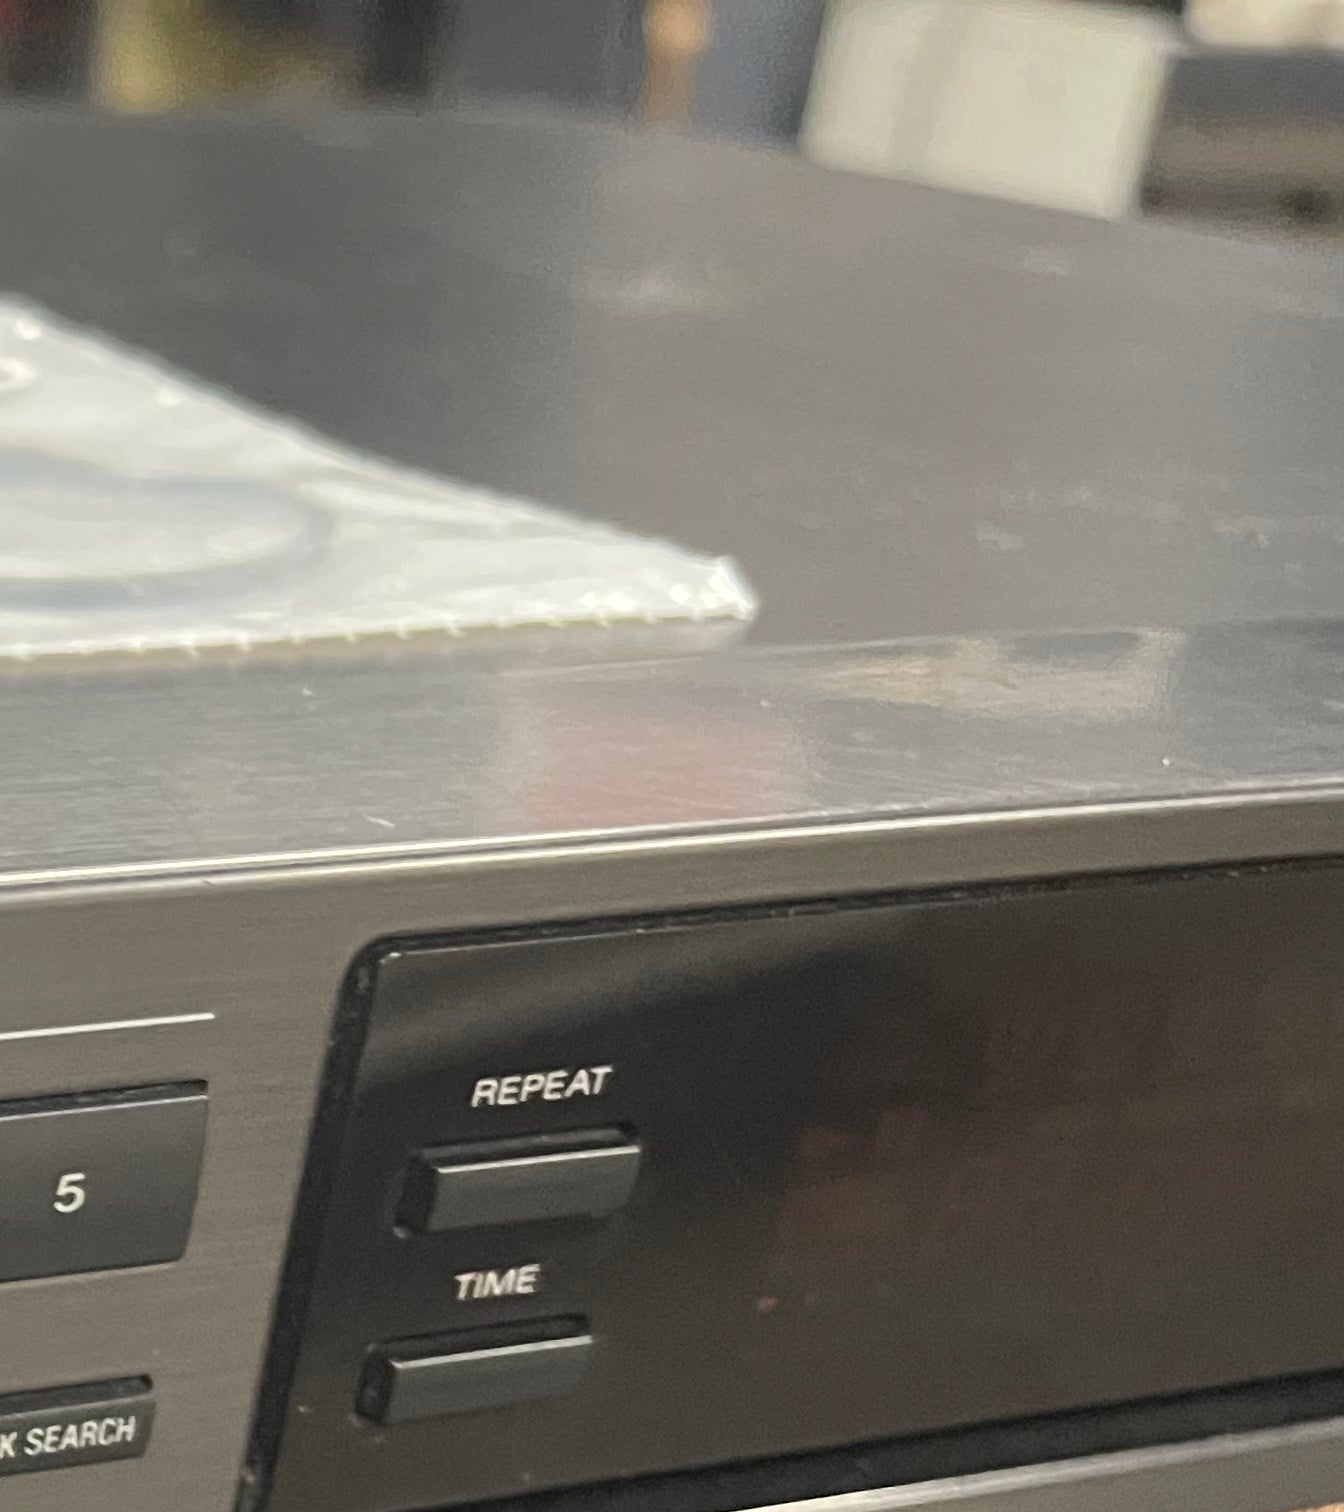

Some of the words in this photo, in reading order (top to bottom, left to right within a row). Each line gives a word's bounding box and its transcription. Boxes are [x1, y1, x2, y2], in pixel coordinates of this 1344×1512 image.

[471, 1065, 613, 1108] REPEAT
[54, 1171, 86, 1214] 5
[454, 1262, 541, 1302] TIME
[24, 1415, 136, 1457] SEARCH
